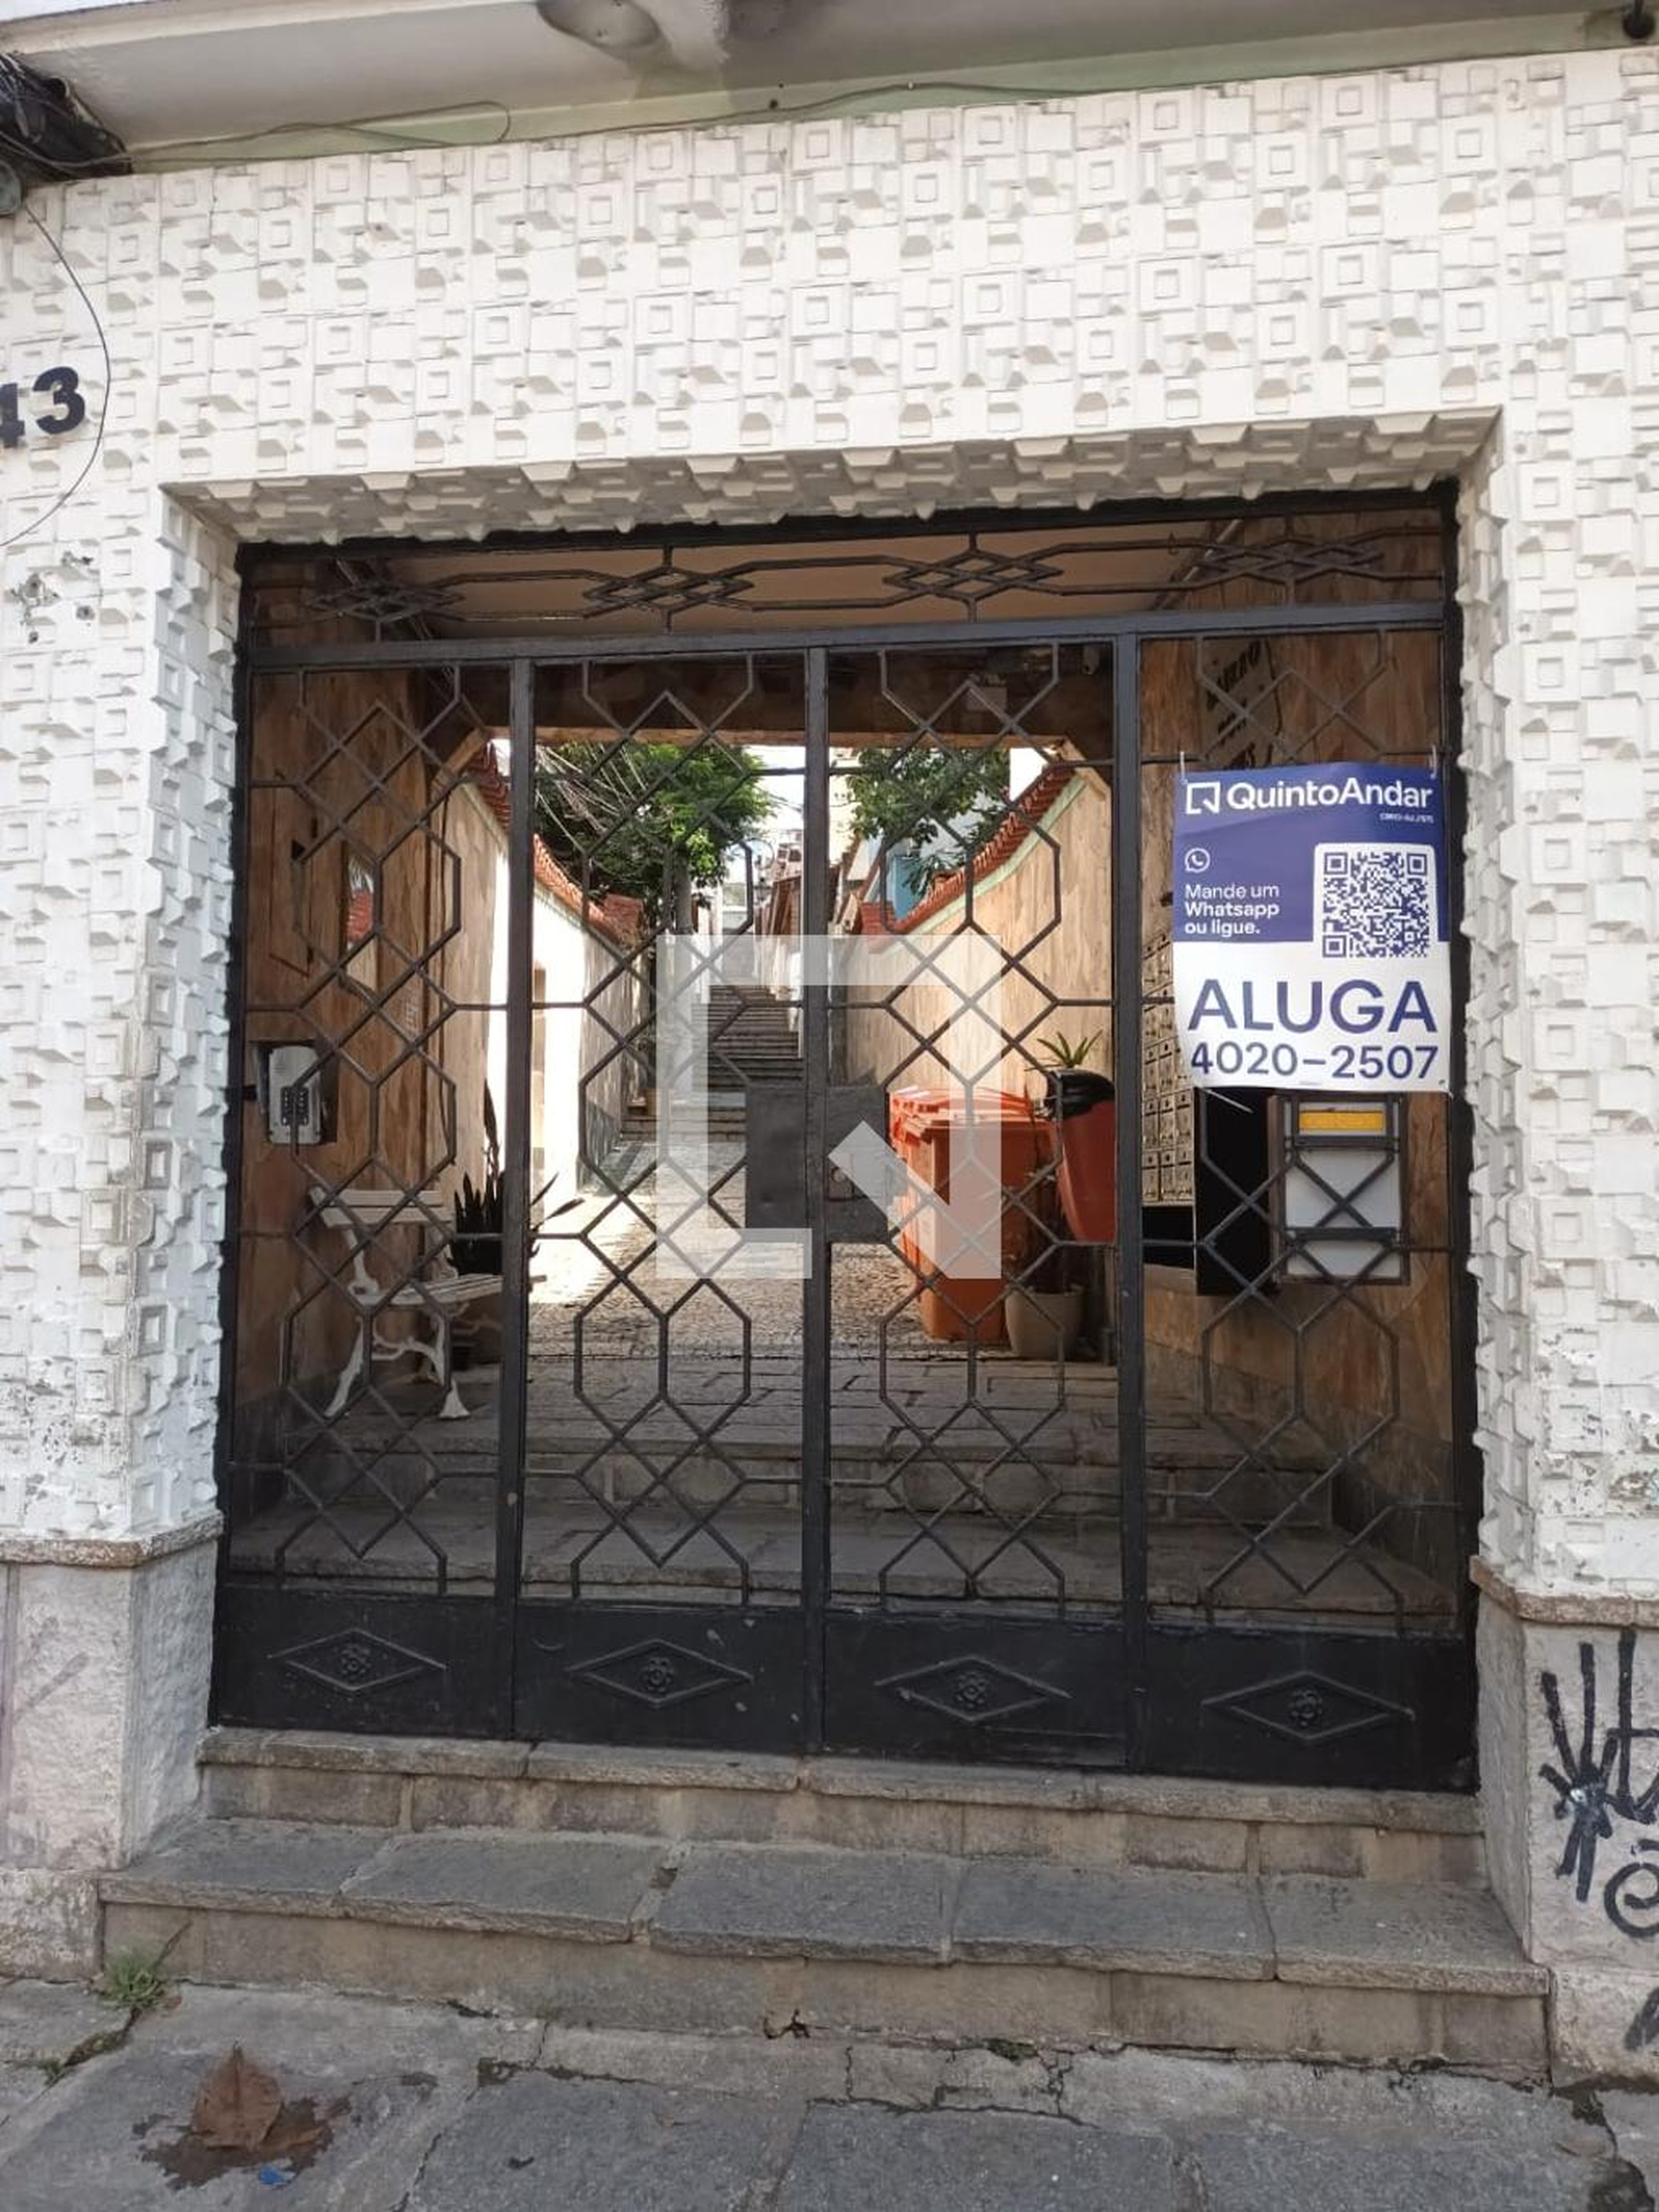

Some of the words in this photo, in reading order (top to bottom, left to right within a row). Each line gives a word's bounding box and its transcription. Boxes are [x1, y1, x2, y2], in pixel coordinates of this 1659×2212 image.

[1227, 777, 1433, 810] QuintoAndar
[1185, 883, 1246, 899] Mande
[1250, 885, 1280, 898] um
[1185, 901, 1280, 919] Whatsapp
[1185, 922, 1207, 934] ou
[1211, 918, 1261, 937] ligue.
[1187, 979, 1437, 1034] ALUGA
[1191, 1041, 1439, 1079] 4020-2507
